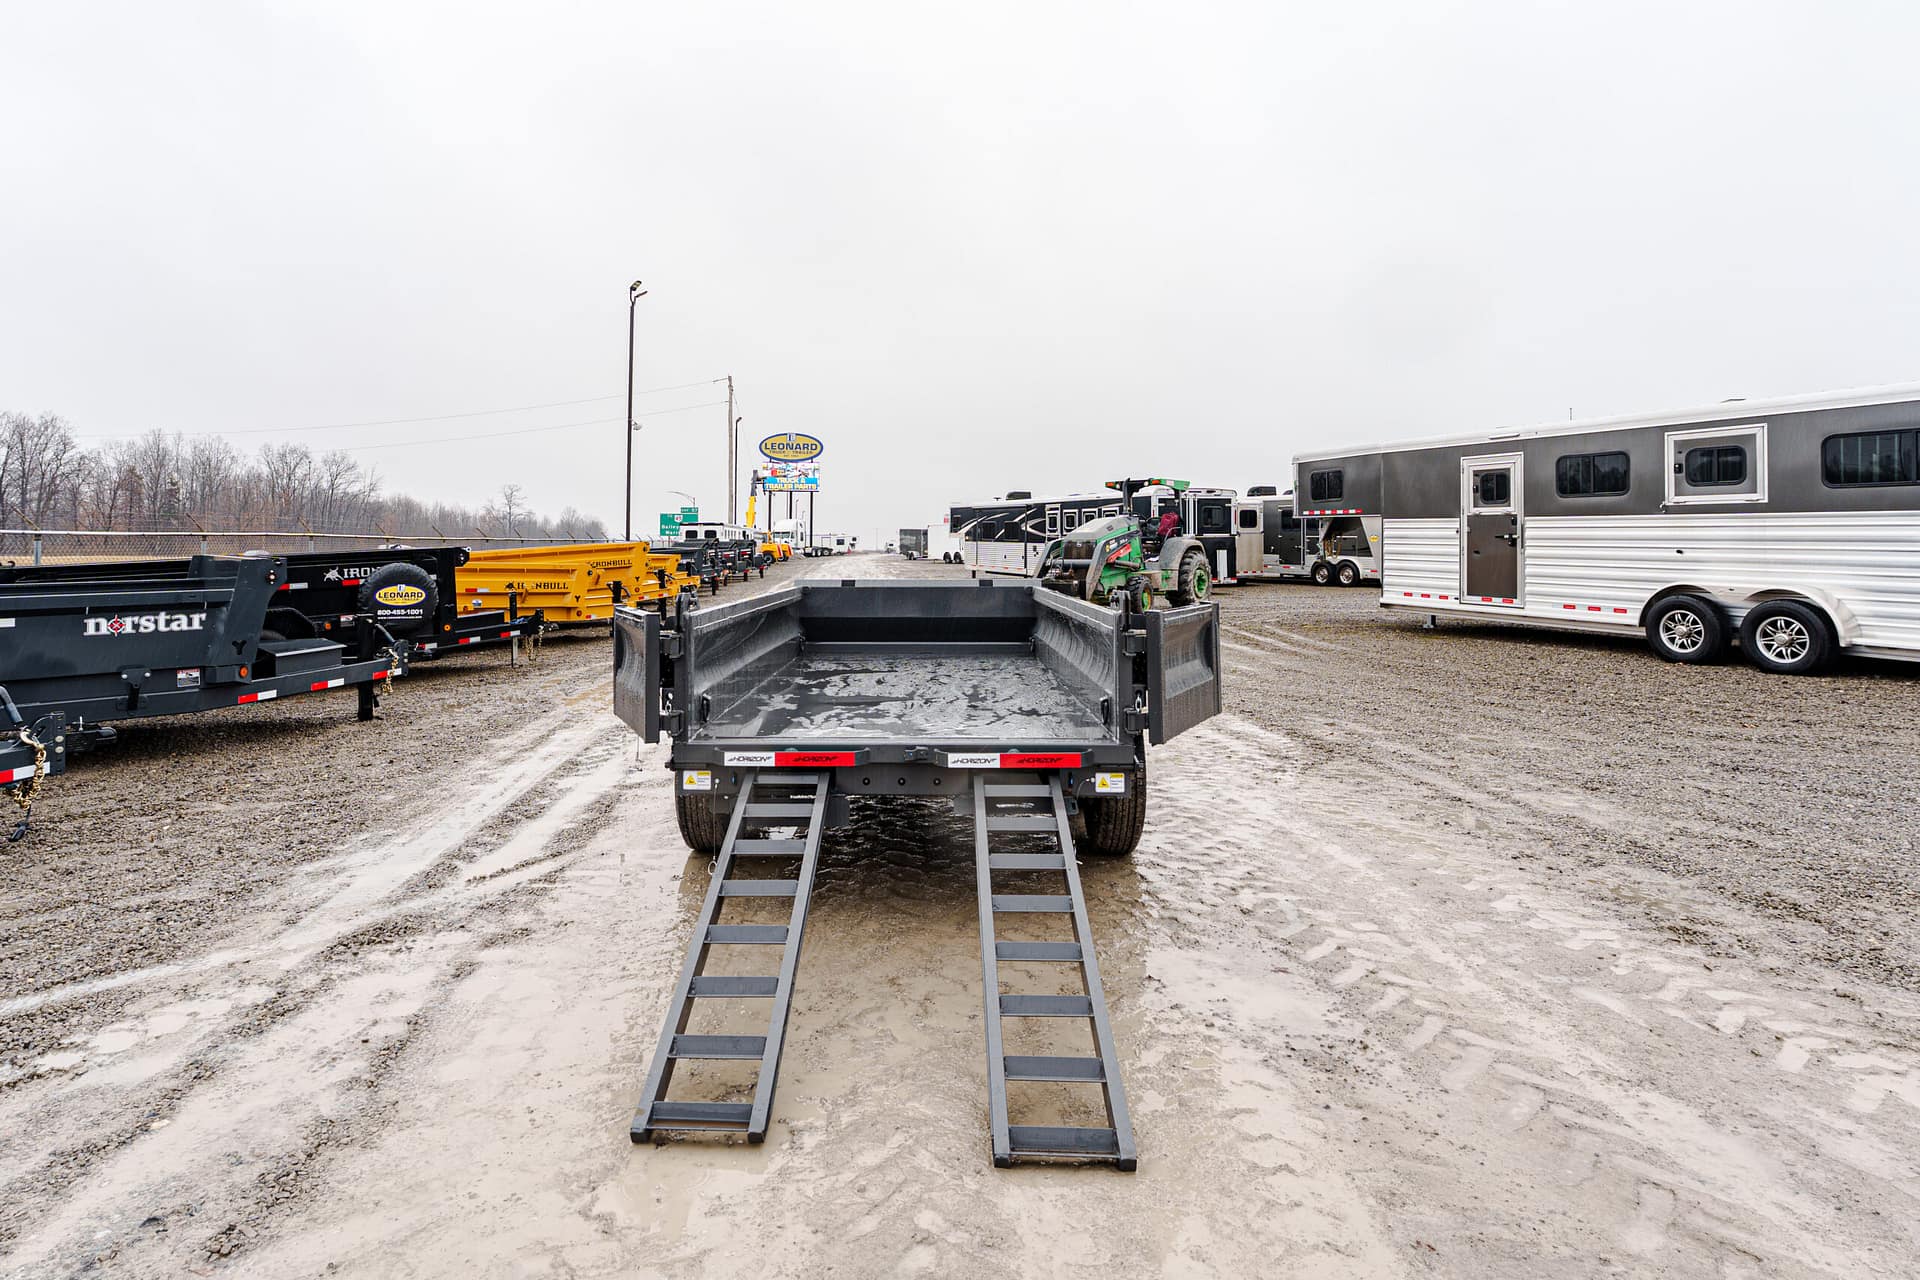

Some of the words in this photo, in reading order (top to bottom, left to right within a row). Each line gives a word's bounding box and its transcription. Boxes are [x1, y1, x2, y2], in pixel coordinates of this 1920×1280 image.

[764, 442, 818, 450] LEONARD
[517, 582, 568, 590] INBULL
[83, 611, 207, 637] norstar
